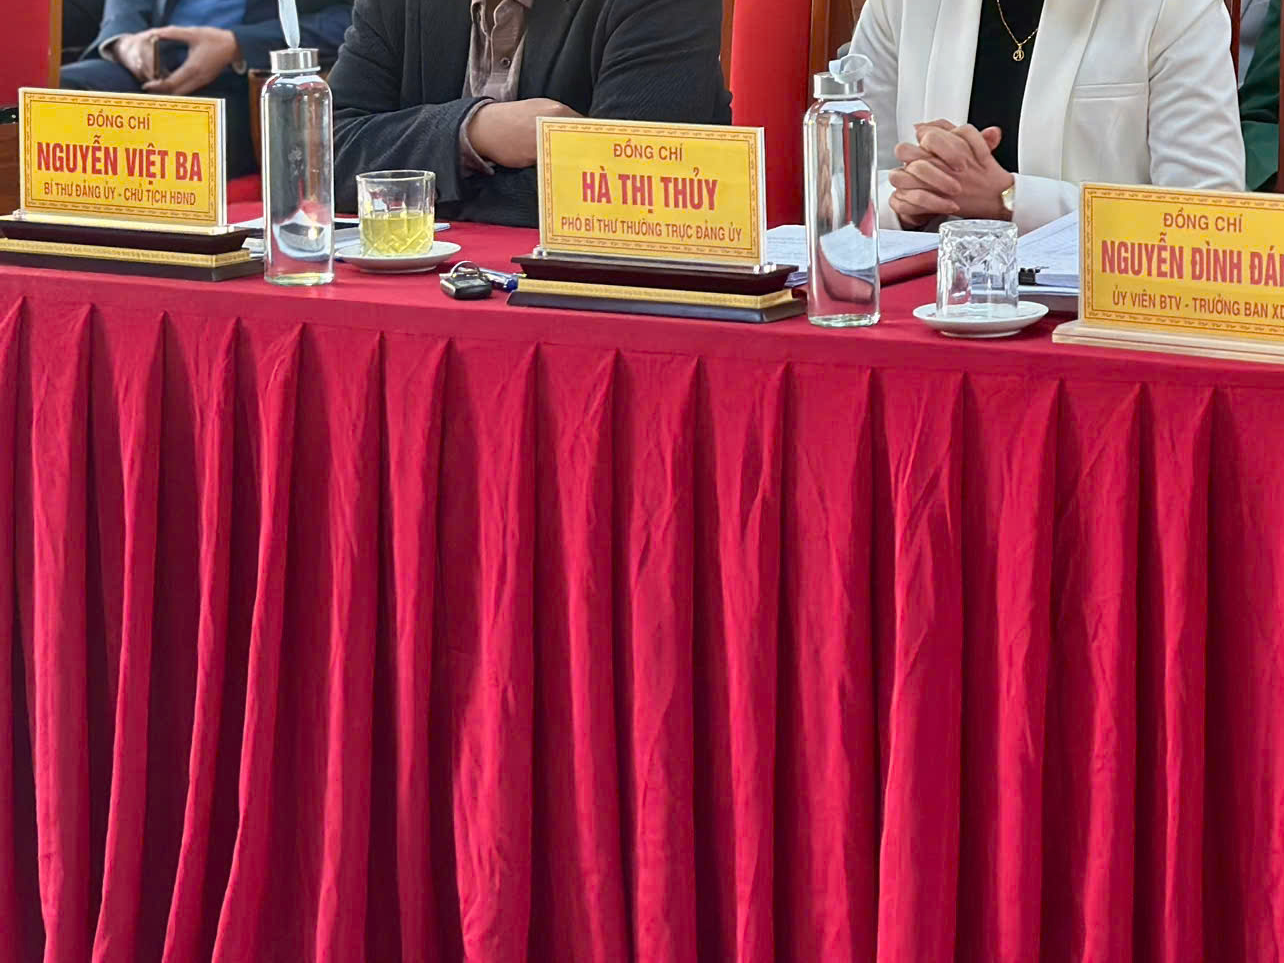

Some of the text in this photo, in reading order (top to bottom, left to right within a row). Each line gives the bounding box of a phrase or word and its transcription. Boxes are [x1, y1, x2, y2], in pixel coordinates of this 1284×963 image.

[128, 113, 150, 130] CHÍ
[37, 135, 203, 185] NGUYỄN VIỆT BA
[659, 143, 683, 161] CHÍ
[44, 179, 53, 194] BÍ
[55, 182, 73, 197] THƯ
[75, 179, 101, 199] ĐẢNG
[104, 181, 116, 200] ỦY
[124, 184, 144, 203] CHỦ
[146, 191, 167, 206] TỊCH
[170, 191, 196, 206] HĐND
[582, 166, 718, 213] HÀ THỊ THỦY
[561, 214, 742, 242] PHÓ BÍ THƯ THƯỜNG TRỰC ĐẢNG ỦY
[1215, 213, 1243, 233] CHÍ
[1101, 232, 1184, 279] NGUYỄN
[1191, 240, 1242, 284] ĐÌNH
[1112, 285, 1127, 306] ỦY
[1131, 289, 1156, 309] VIÊN
[1160, 295, 1181, 310] BTV
[1192, 293, 1240, 316] TRƯỞNG
[1244, 302, 1268, 318] BAN
